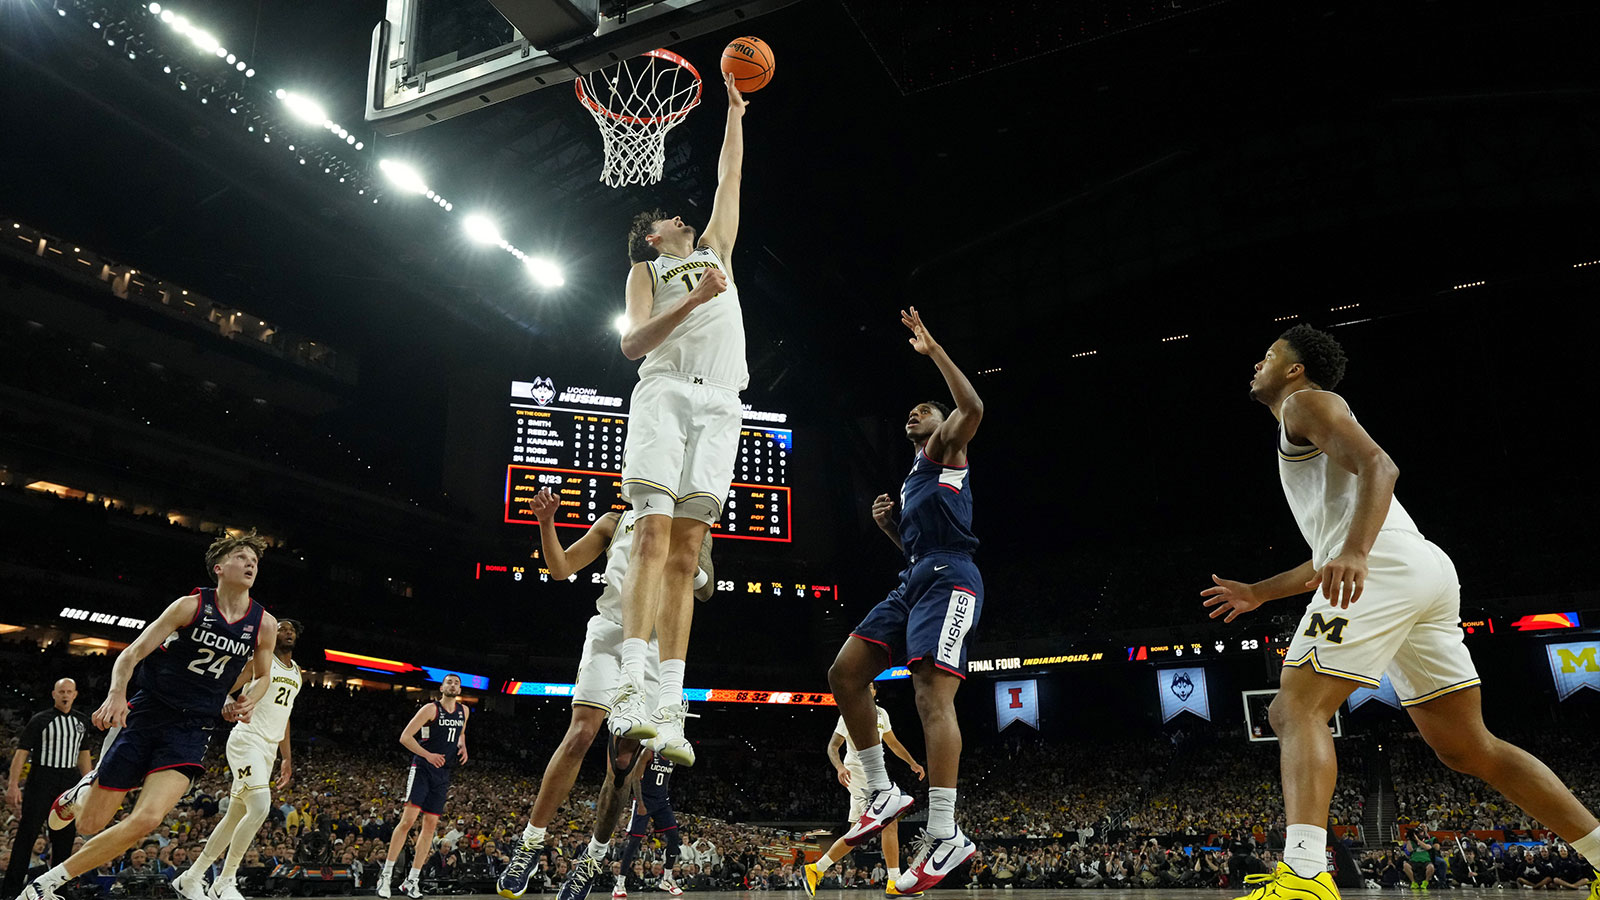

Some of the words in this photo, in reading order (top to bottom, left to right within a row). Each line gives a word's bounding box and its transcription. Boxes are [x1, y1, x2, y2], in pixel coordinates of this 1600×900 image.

[661, 261, 720, 284] MICHIGAN
[693, 376, 704, 385] M
[566, 387, 597, 395] UCONN
[559, 393, 623, 407] HUSKIES
[528, 419, 551, 427] SMITH
[527, 428, 548, 436] REED
[527, 438, 563, 447] KARABAN
[526, 456, 558, 465] MULLINS
[539, 475, 562, 484] 8/23
[589, 479, 596, 487] 2
[589, 490, 596, 498] 7
[771, 493, 778, 501] 2
[771, 504, 778, 512] 2
[587, 513, 596, 521] 0
[771, 515, 778, 523] 0
[729, 523, 735, 531] 2
[514, 572, 523, 581] 9
[540, 574, 549, 583] 4
[717, 580, 735, 591] 23
[747, 582, 762, 593] M
[773, 588, 782, 596] 4
[796, 589, 805, 598] 4
[117, 617, 146, 630] MEN'S
[943, 595, 969, 660] HUSKIES
[1303, 612, 1349, 645] M
[191, 627, 251, 657] UCONN
[1241, 639, 1259, 650] 23
[187, 648, 232, 679] 24
[968, 661, 995, 672] FINAL
[995, 657, 1021, 670] FOUR
[1022, 654, 1090, 666] INDIANAPOLIS,
[1091, 652, 1103, 661] IN
[1556, 647, 1600, 674] M
[272, 676, 299, 690] MICHIGAN
[544, 686, 569, 694] THE
[274, 686, 292, 707] 21
[736, 692, 748, 701] 68
[752, 692, 768, 702] 32
[768, 692, 792, 704] 16
[791, 694, 804, 702] 8
[809, 695, 822, 703] 4
[1008, 687, 1023, 709] I
[438, 718, 464, 727] UCONN
[447, 727, 457, 743] 11
[237, 765, 252, 780] M
[650, 763, 673, 774] UCONN
[655, 772, 665, 786] 0
